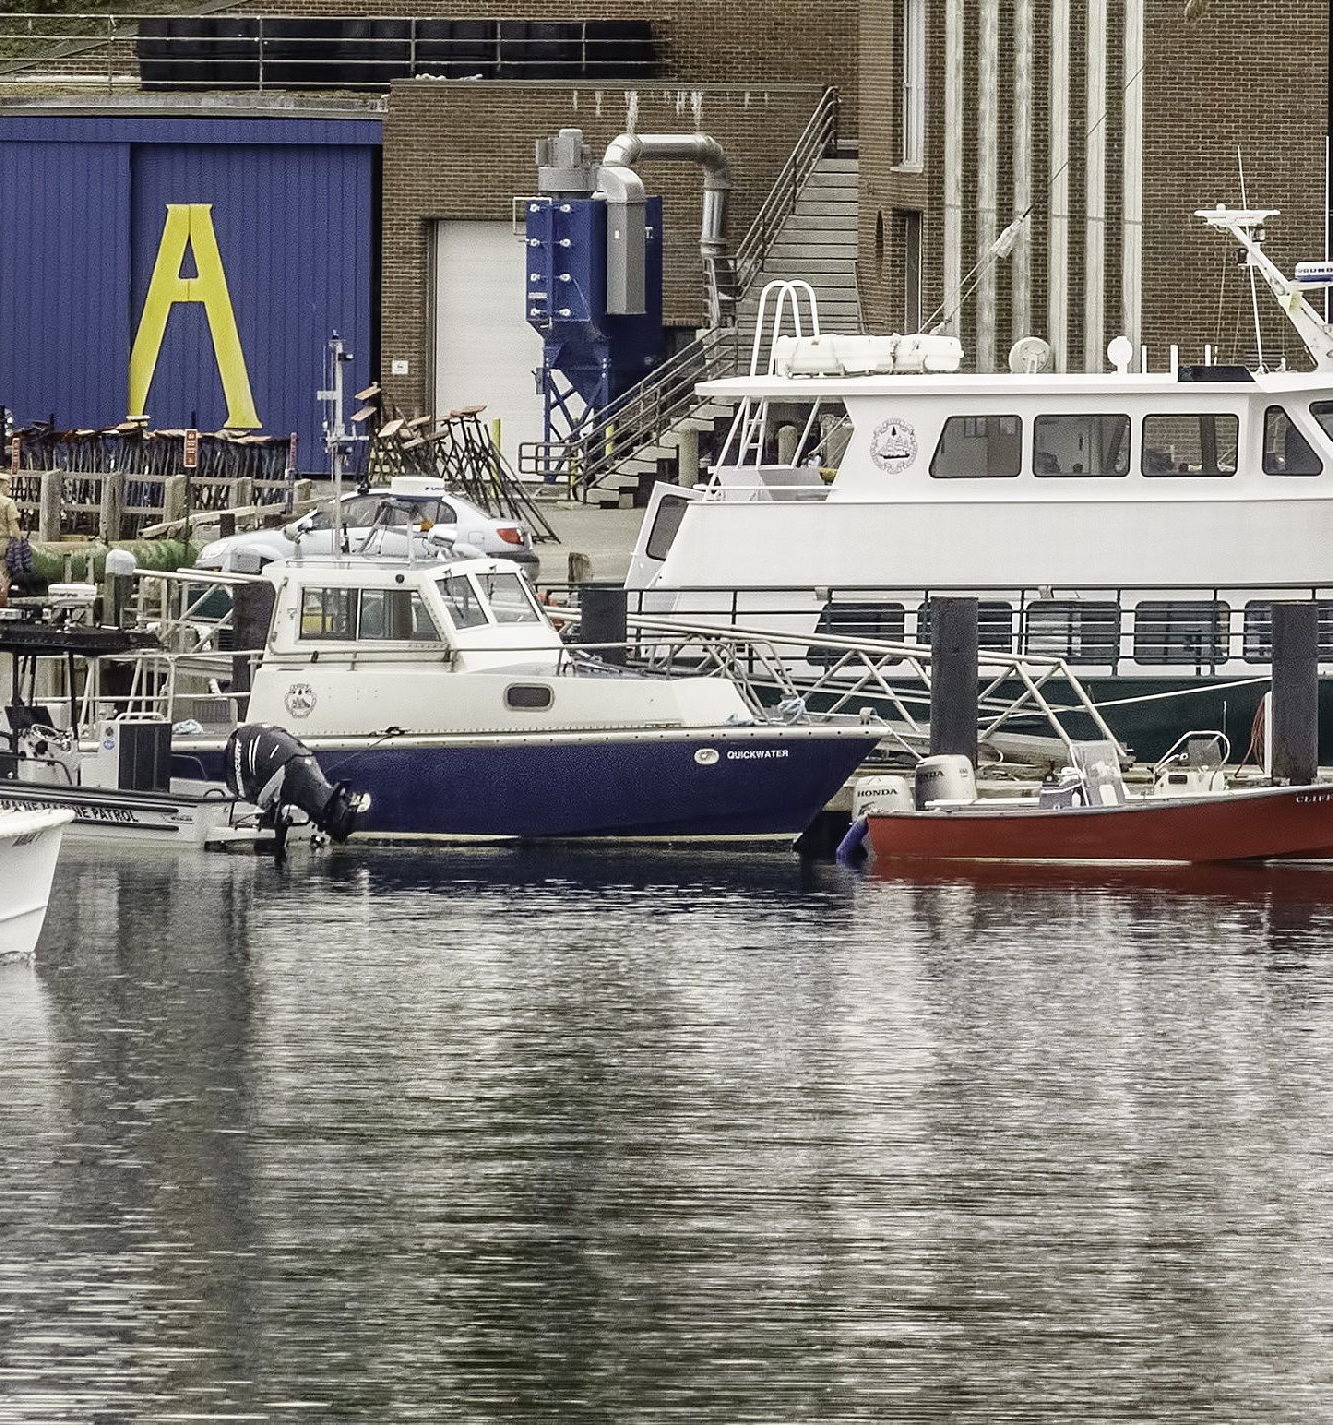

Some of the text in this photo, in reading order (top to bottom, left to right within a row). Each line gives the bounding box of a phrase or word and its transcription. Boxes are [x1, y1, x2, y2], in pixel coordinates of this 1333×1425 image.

[726, 749, 789, 760] QUICKWATER
[857, 787, 899, 798] HONDA
[91, 806, 139, 823] PATROL
